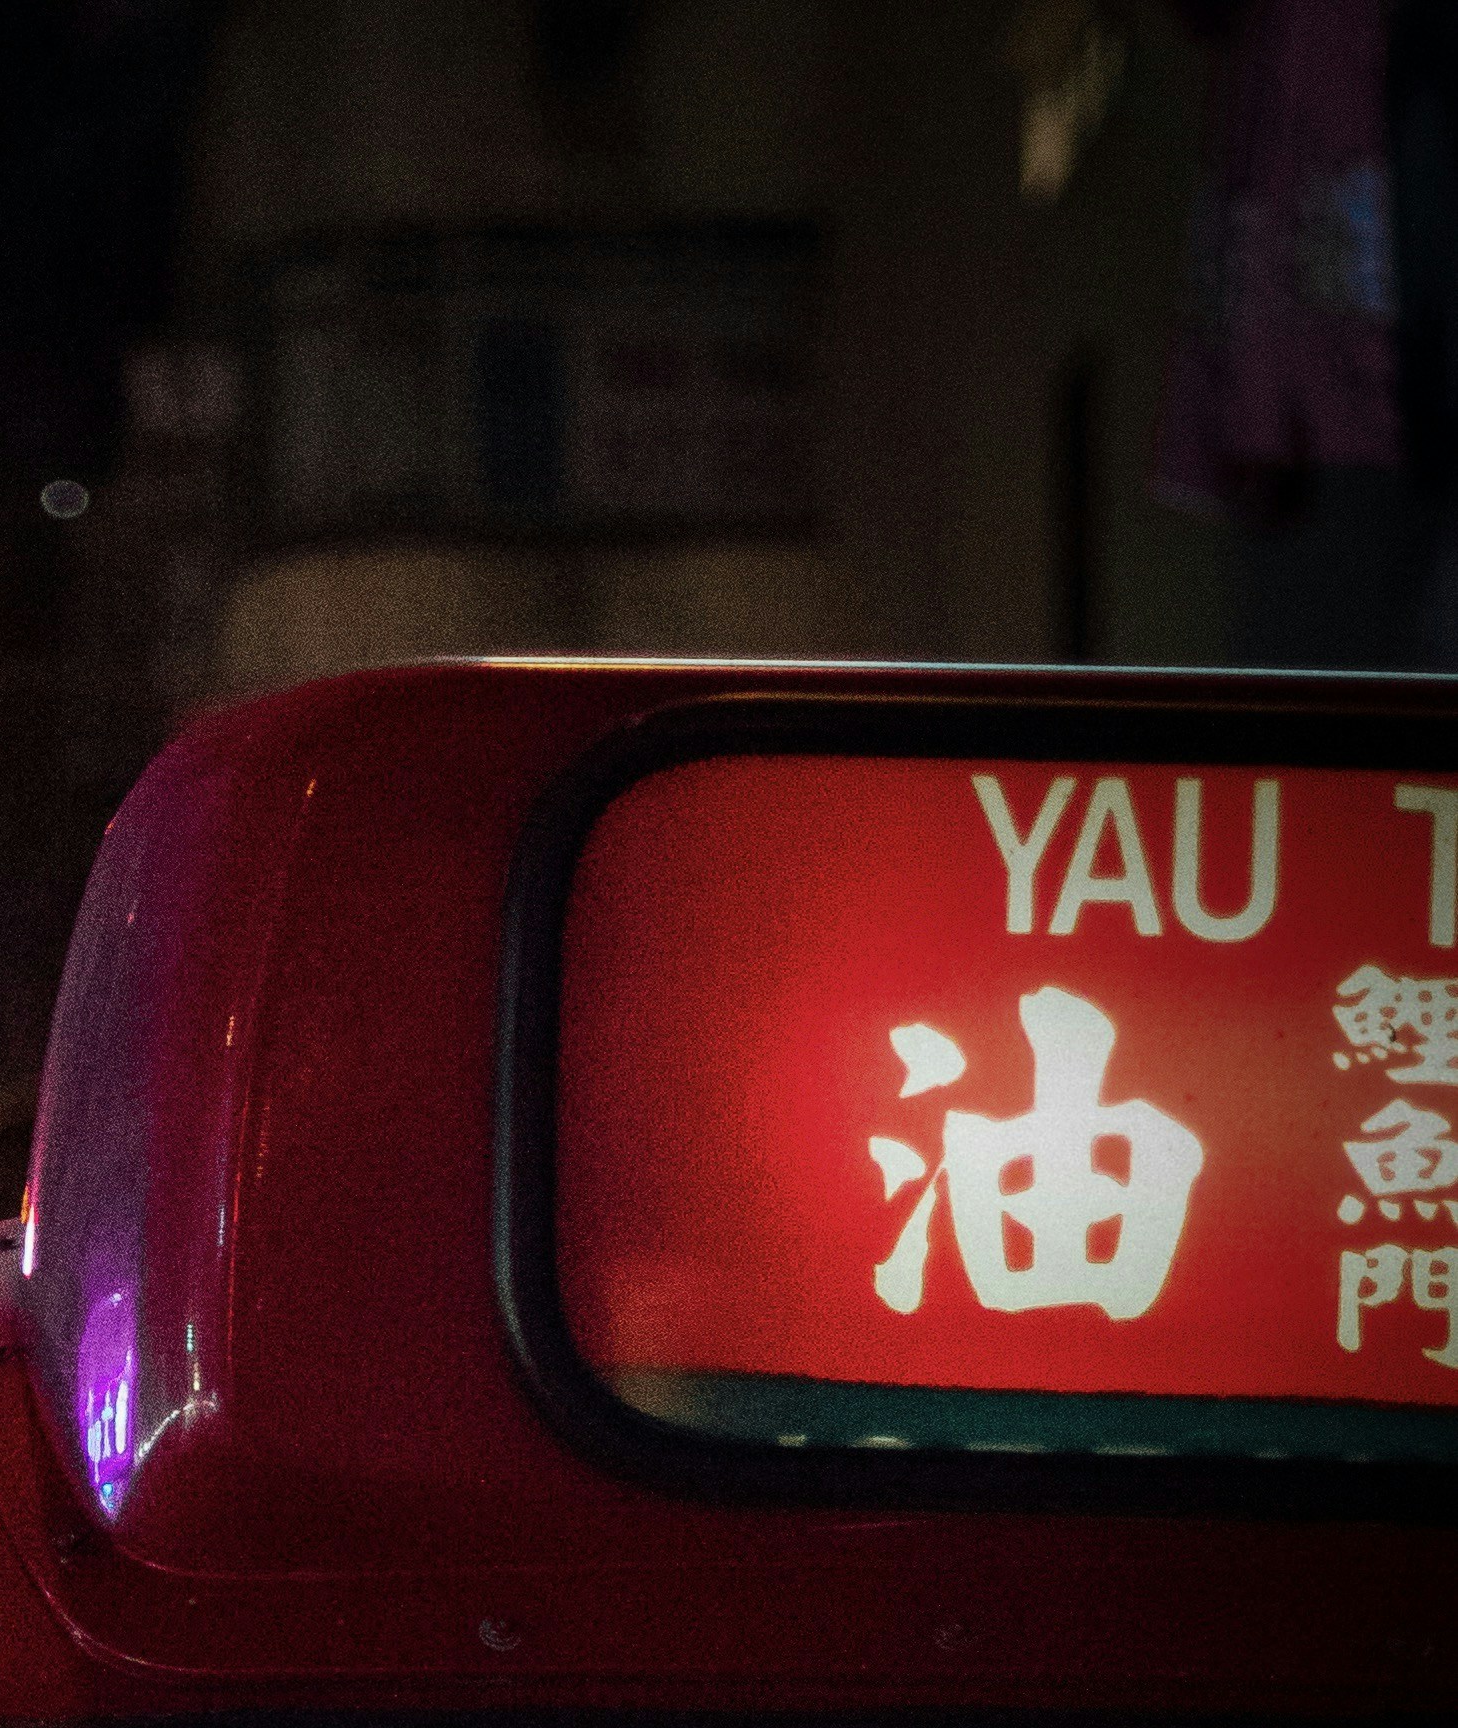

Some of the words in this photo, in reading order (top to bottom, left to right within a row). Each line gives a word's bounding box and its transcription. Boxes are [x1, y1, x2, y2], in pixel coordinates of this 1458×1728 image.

[971, 773, 1283, 943] YAU
[867, 985, 1205, 1321] 油
[1332, 963, 1458, 1371] 鯉魚門
